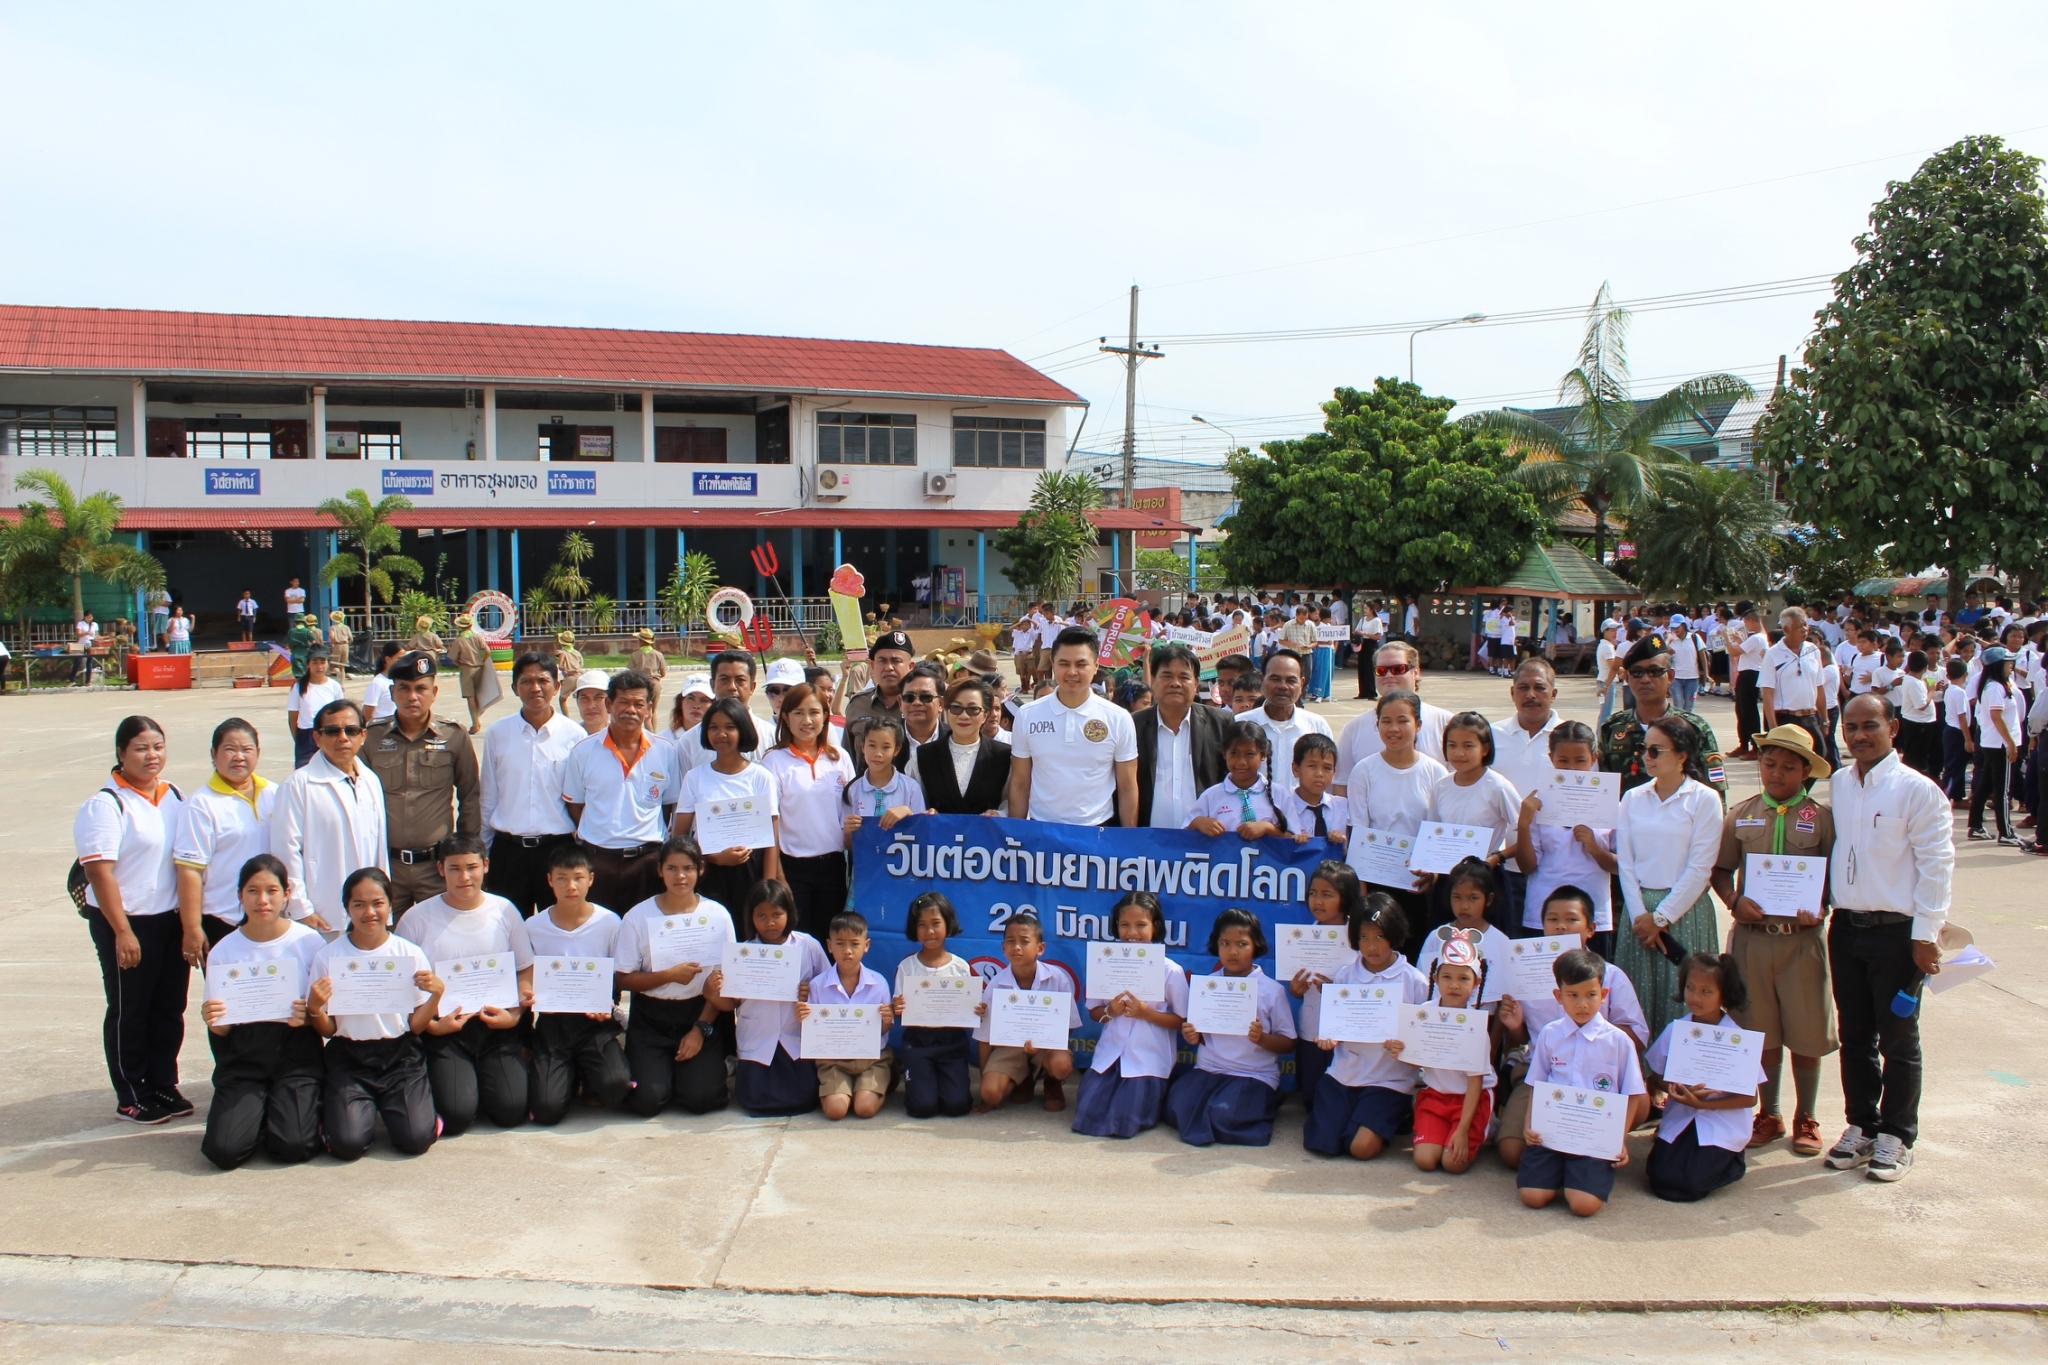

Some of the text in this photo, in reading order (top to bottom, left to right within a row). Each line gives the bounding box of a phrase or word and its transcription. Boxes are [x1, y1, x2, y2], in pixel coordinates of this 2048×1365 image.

[210, 472, 255, 489] วิสัยทัศน์
[383, 471, 433, 493] เน้นคุณธรรม
[440, 473, 537, 498] อาคารชุมทอง
[549, 474, 595, 490] นำวิชาการ
[698, 474, 752, 490] ก้าวทันเทคโนโลยี
[1101, 605, 1128, 658] NO DRUGS
[1029, 721, 1055, 734] DOPA
[886, 832, 1305, 902] วันต่อต้านยาเสพติดโลก
